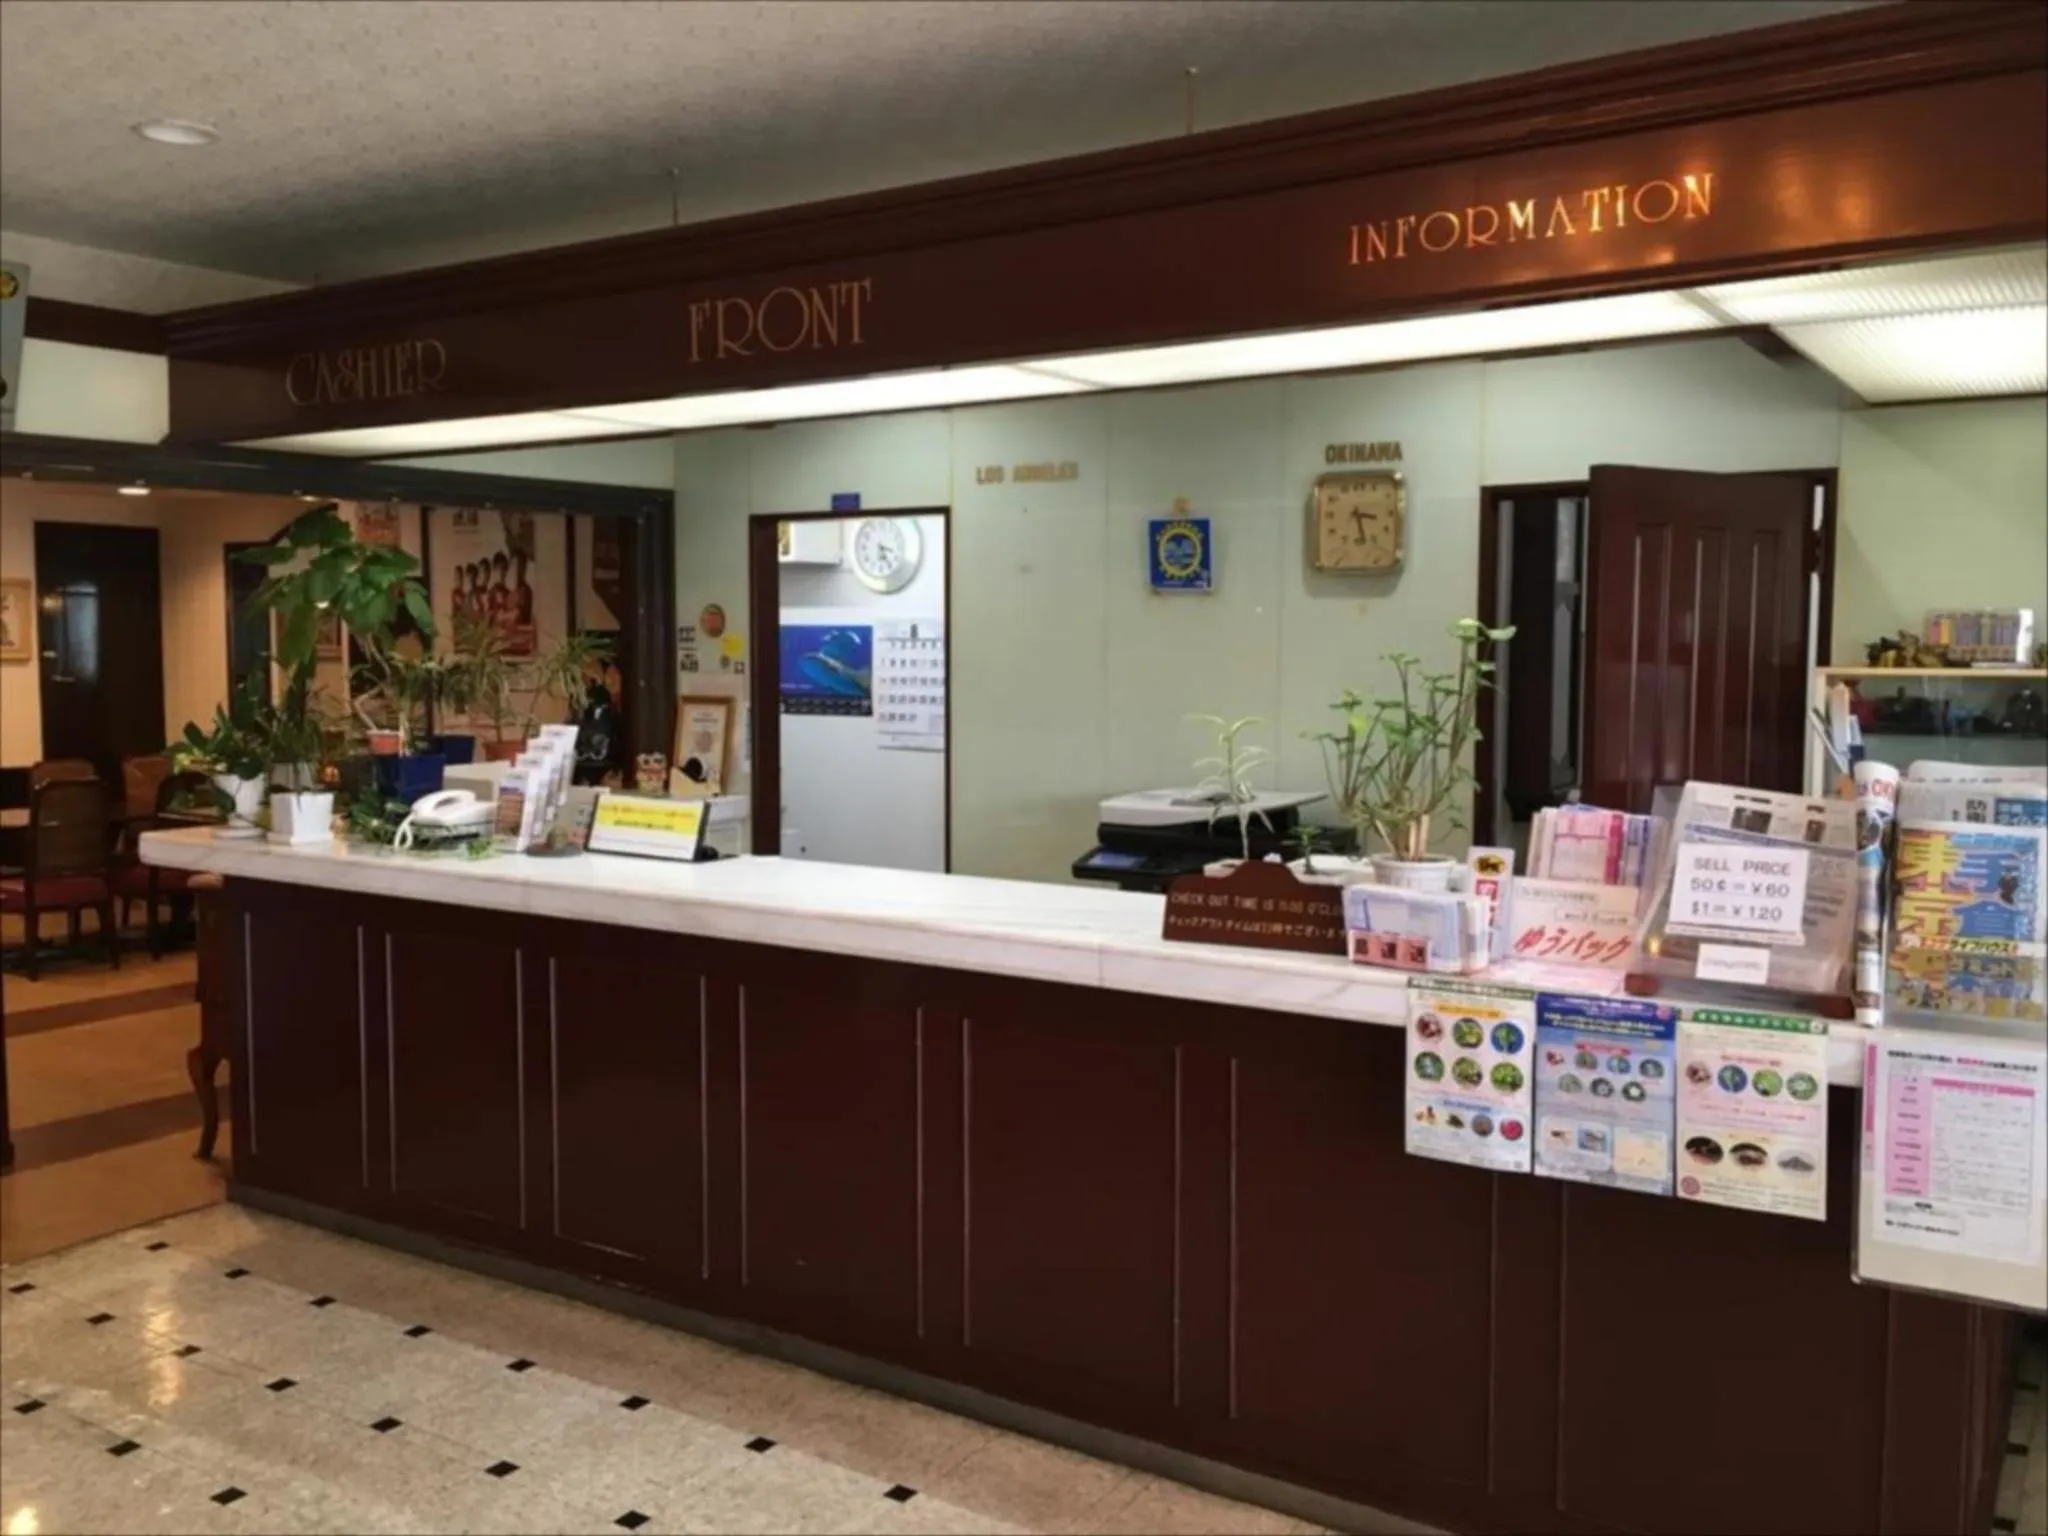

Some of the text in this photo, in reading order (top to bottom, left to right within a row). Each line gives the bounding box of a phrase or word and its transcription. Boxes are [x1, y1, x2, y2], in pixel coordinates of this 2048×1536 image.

[1349, 173, 1713, 264] INFORMATION
[688, 276, 872, 363] FRONT
[285, 338, 447, 407] CASHIER
[1325, 441, 1403, 465] OKINAWA
[1693, 856, 1792, 876] SELL PRICE
[1513, 924, 1632, 963] ゆうパック
